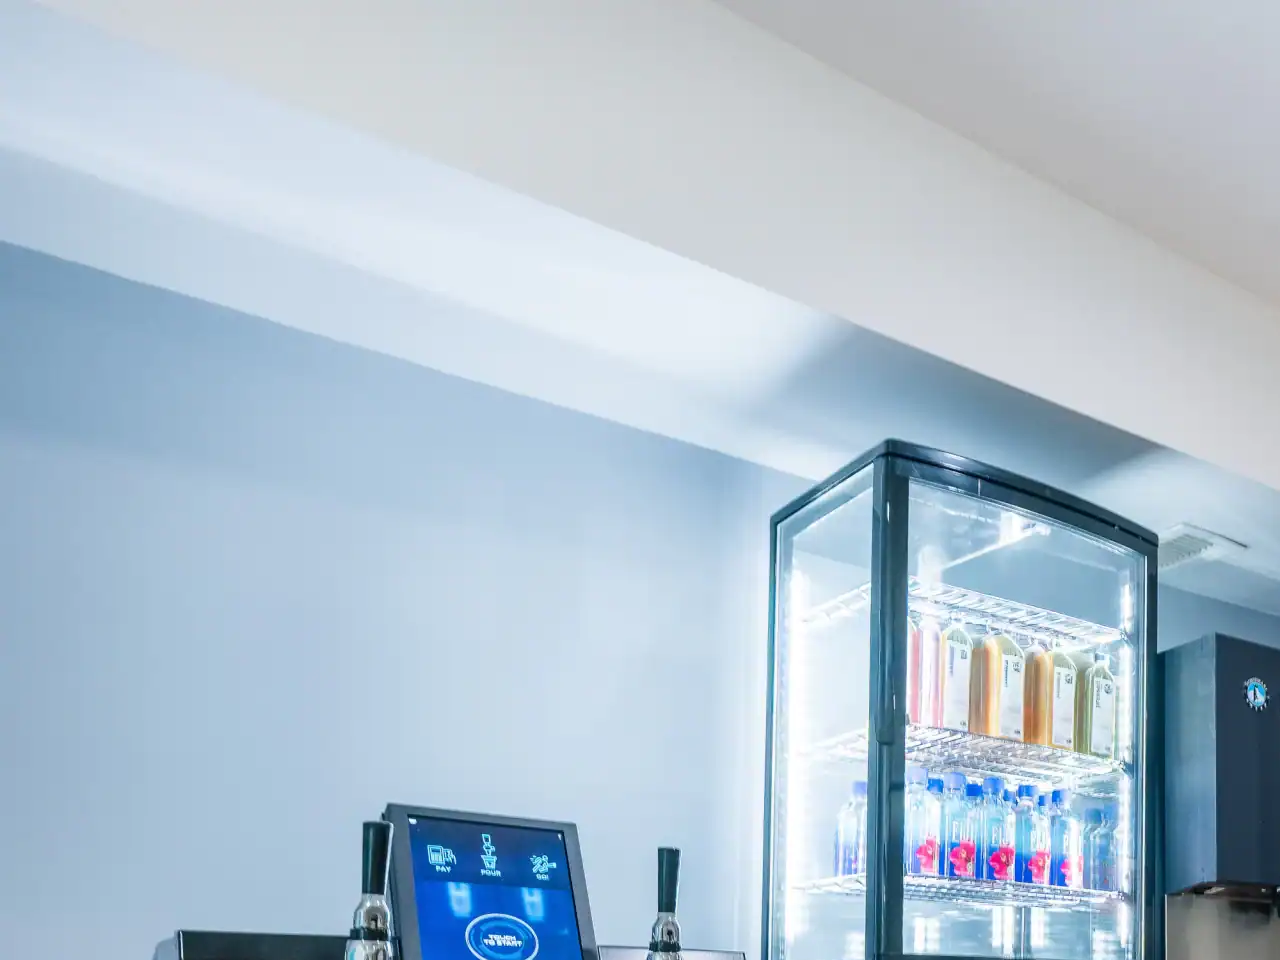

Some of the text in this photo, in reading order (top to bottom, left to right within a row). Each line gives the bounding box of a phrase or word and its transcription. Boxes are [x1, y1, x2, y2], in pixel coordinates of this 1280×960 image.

[436, 865, 452, 873] PAY
[480, 868, 502, 877] POUR
[488, 934, 517, 942] TOUCH
[483, 938, 523, 947] TO START
